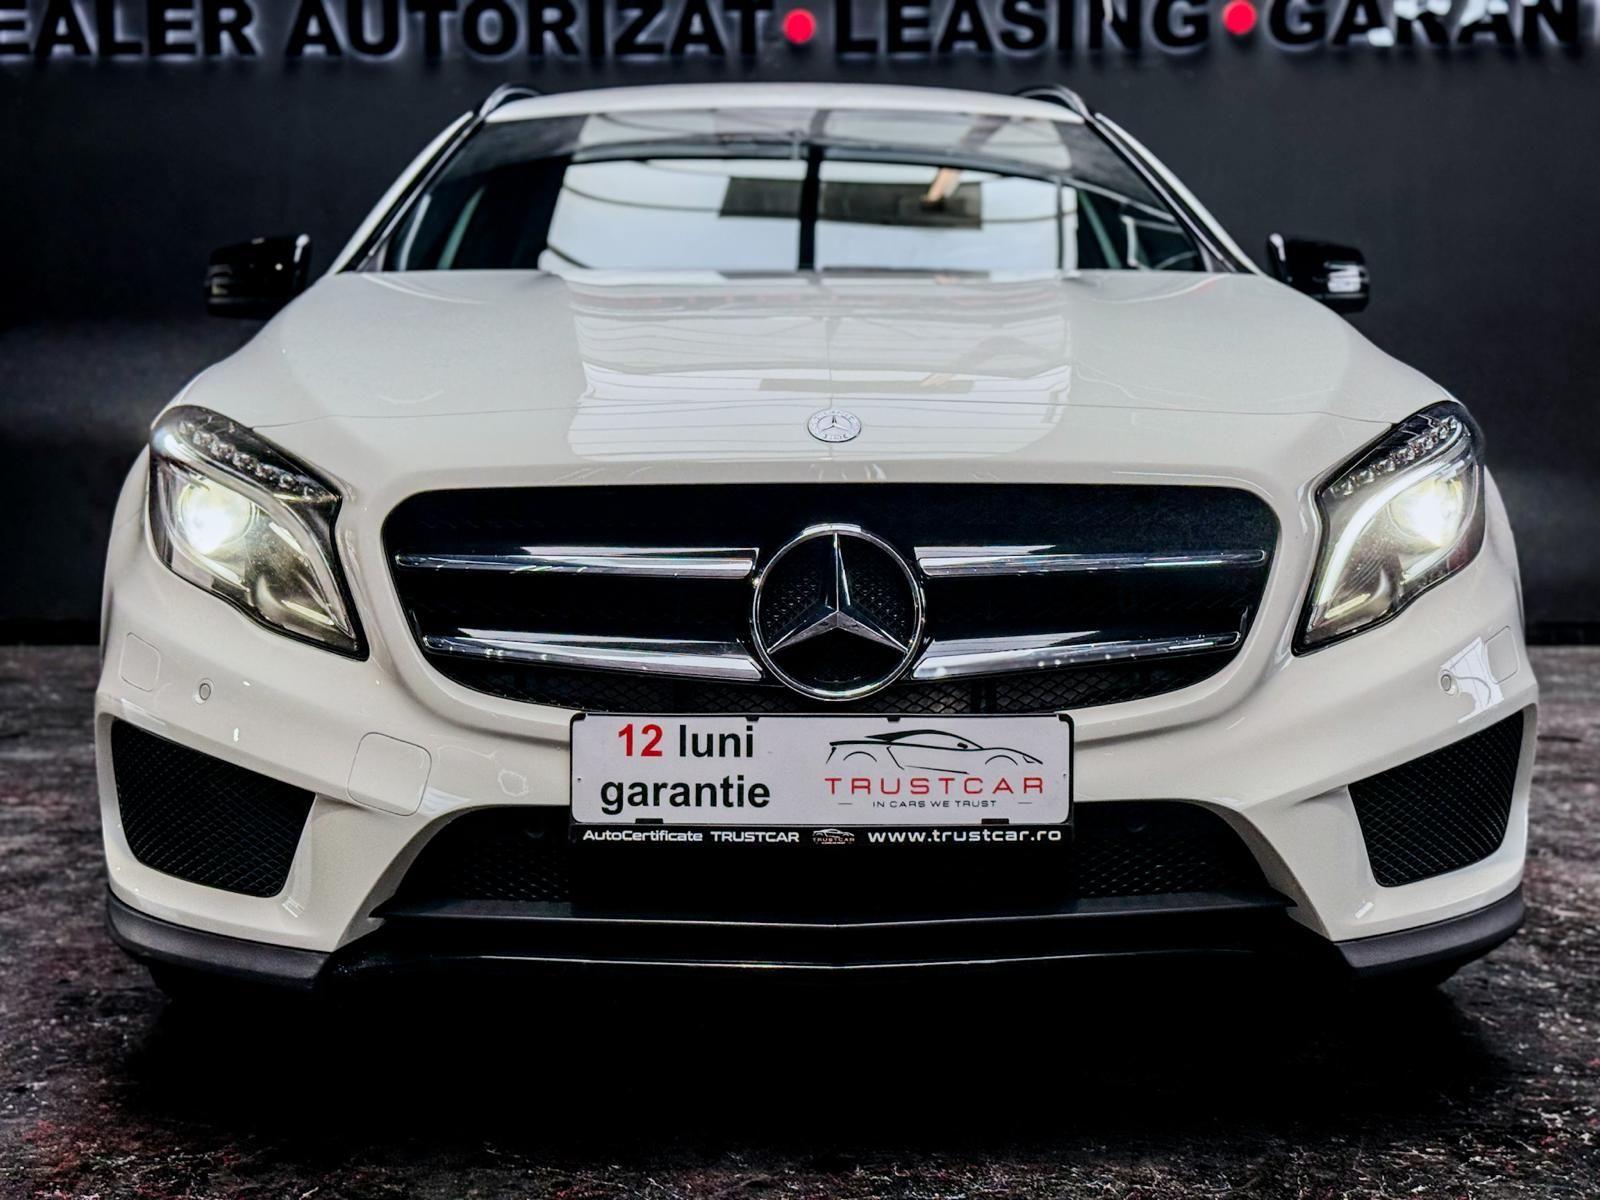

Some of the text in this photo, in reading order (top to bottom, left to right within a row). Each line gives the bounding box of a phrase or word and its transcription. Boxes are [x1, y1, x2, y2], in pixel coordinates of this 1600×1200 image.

[286, 0, 773, 57] AUTORIZAT
[834, 0, 1209, 51] LEASING
[618, 724, 754, 758] 12 luni
[600, 775, 771, 815] garantie
[824, 777, 1043, 795] TRUSTCAR
[583, 830, 800, 842] AutoCertificate TRUSTCAR
[867, 829, 1062, 843] www.trustcar.ro
